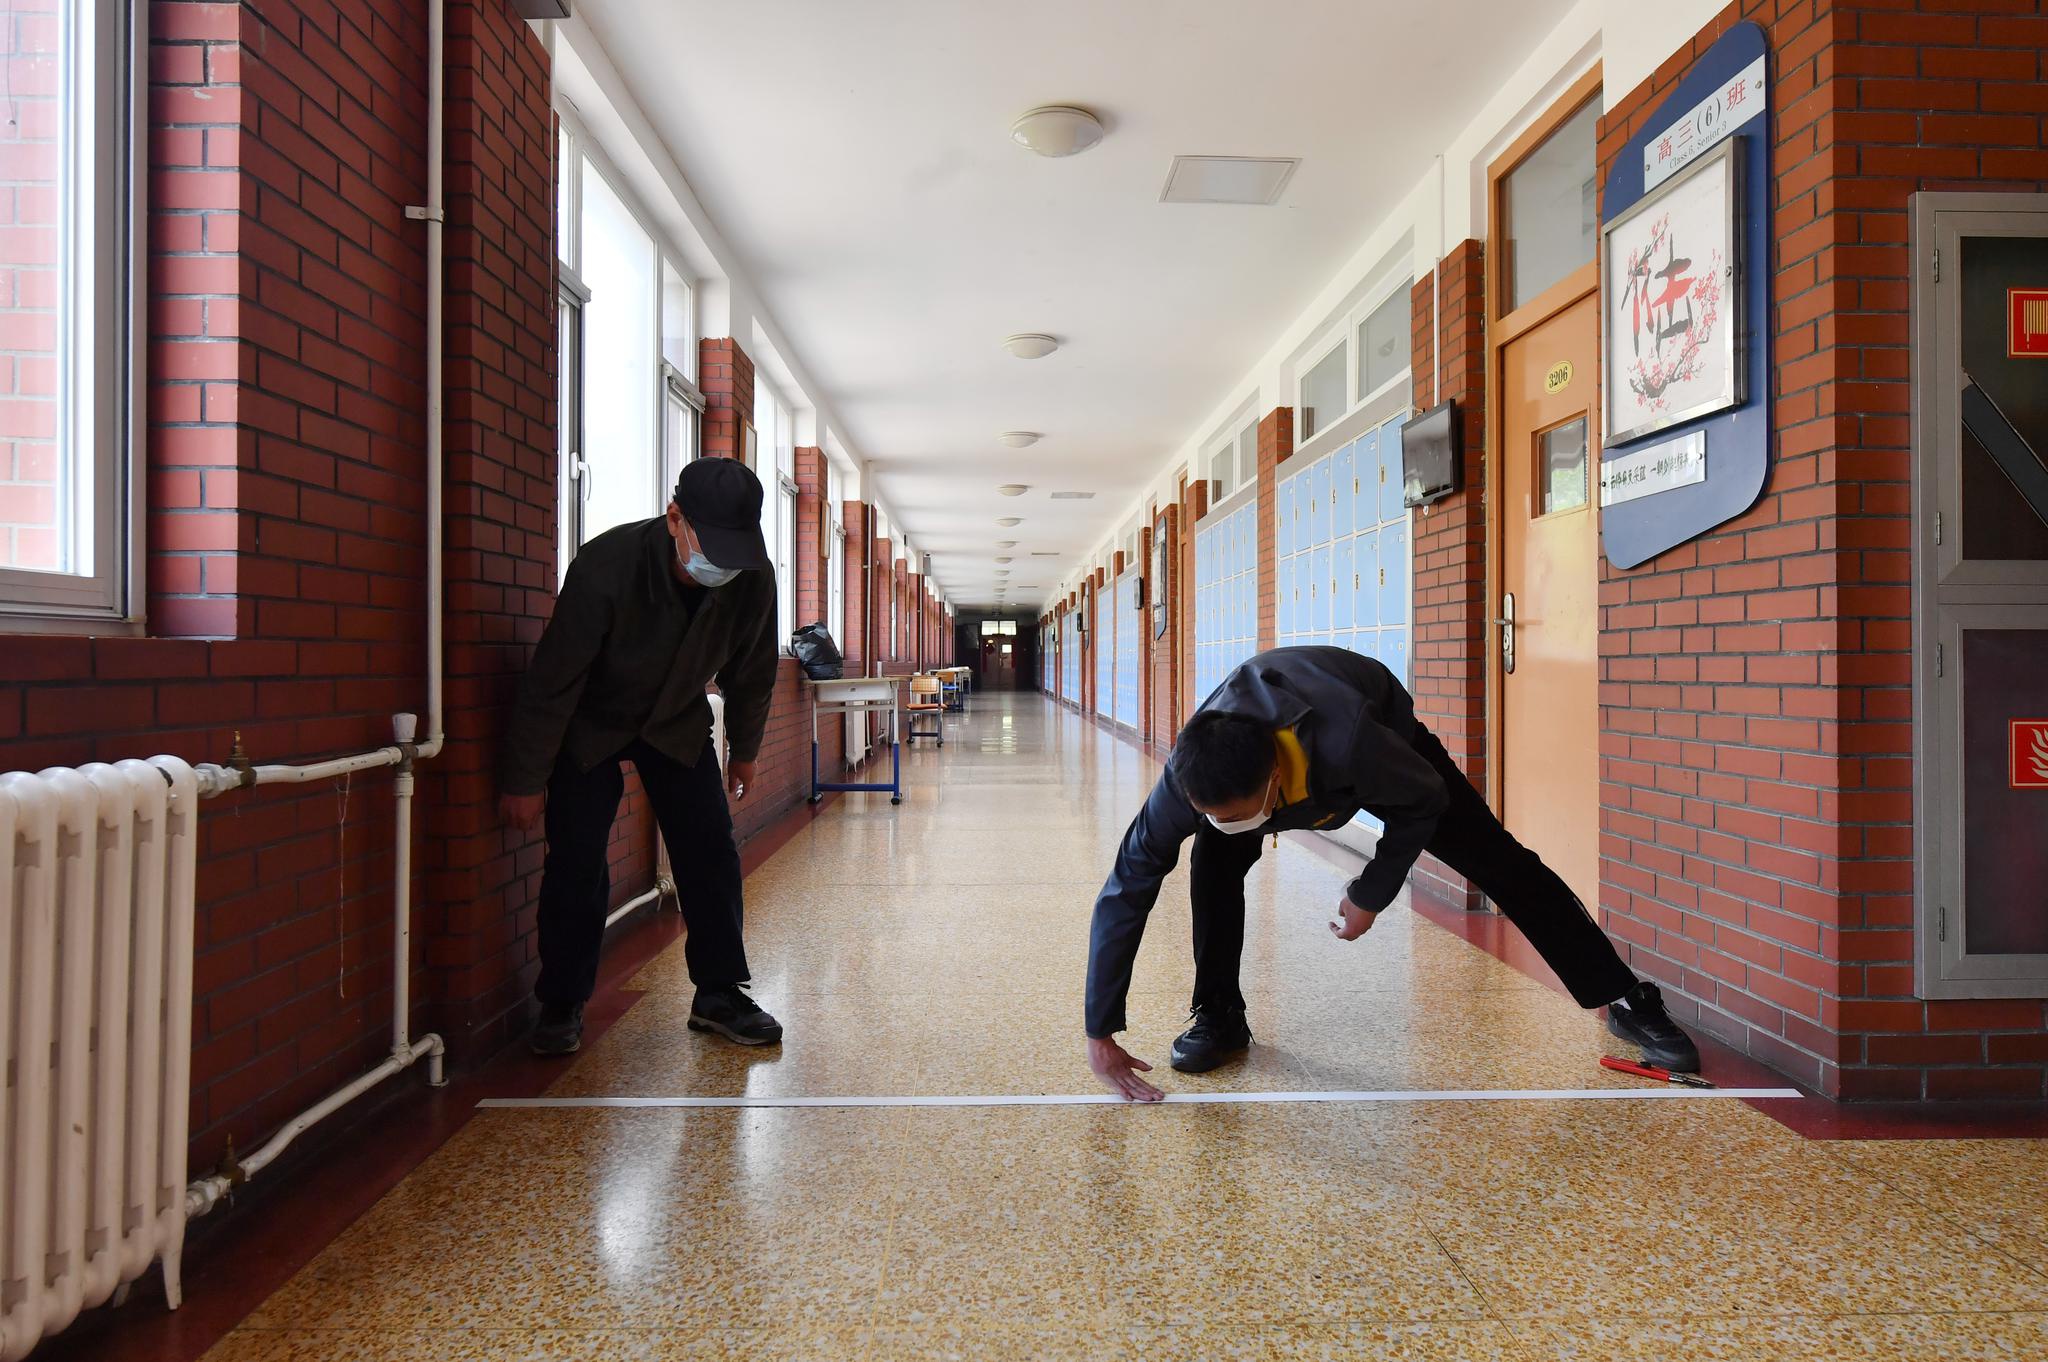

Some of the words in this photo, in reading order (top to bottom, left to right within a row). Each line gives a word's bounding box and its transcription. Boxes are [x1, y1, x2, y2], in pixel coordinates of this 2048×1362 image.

[1669, 150, 1688, 169] Class
[1697, 127, 1720, 150] Senior
[1548, 366, 1568, 388] 3206
